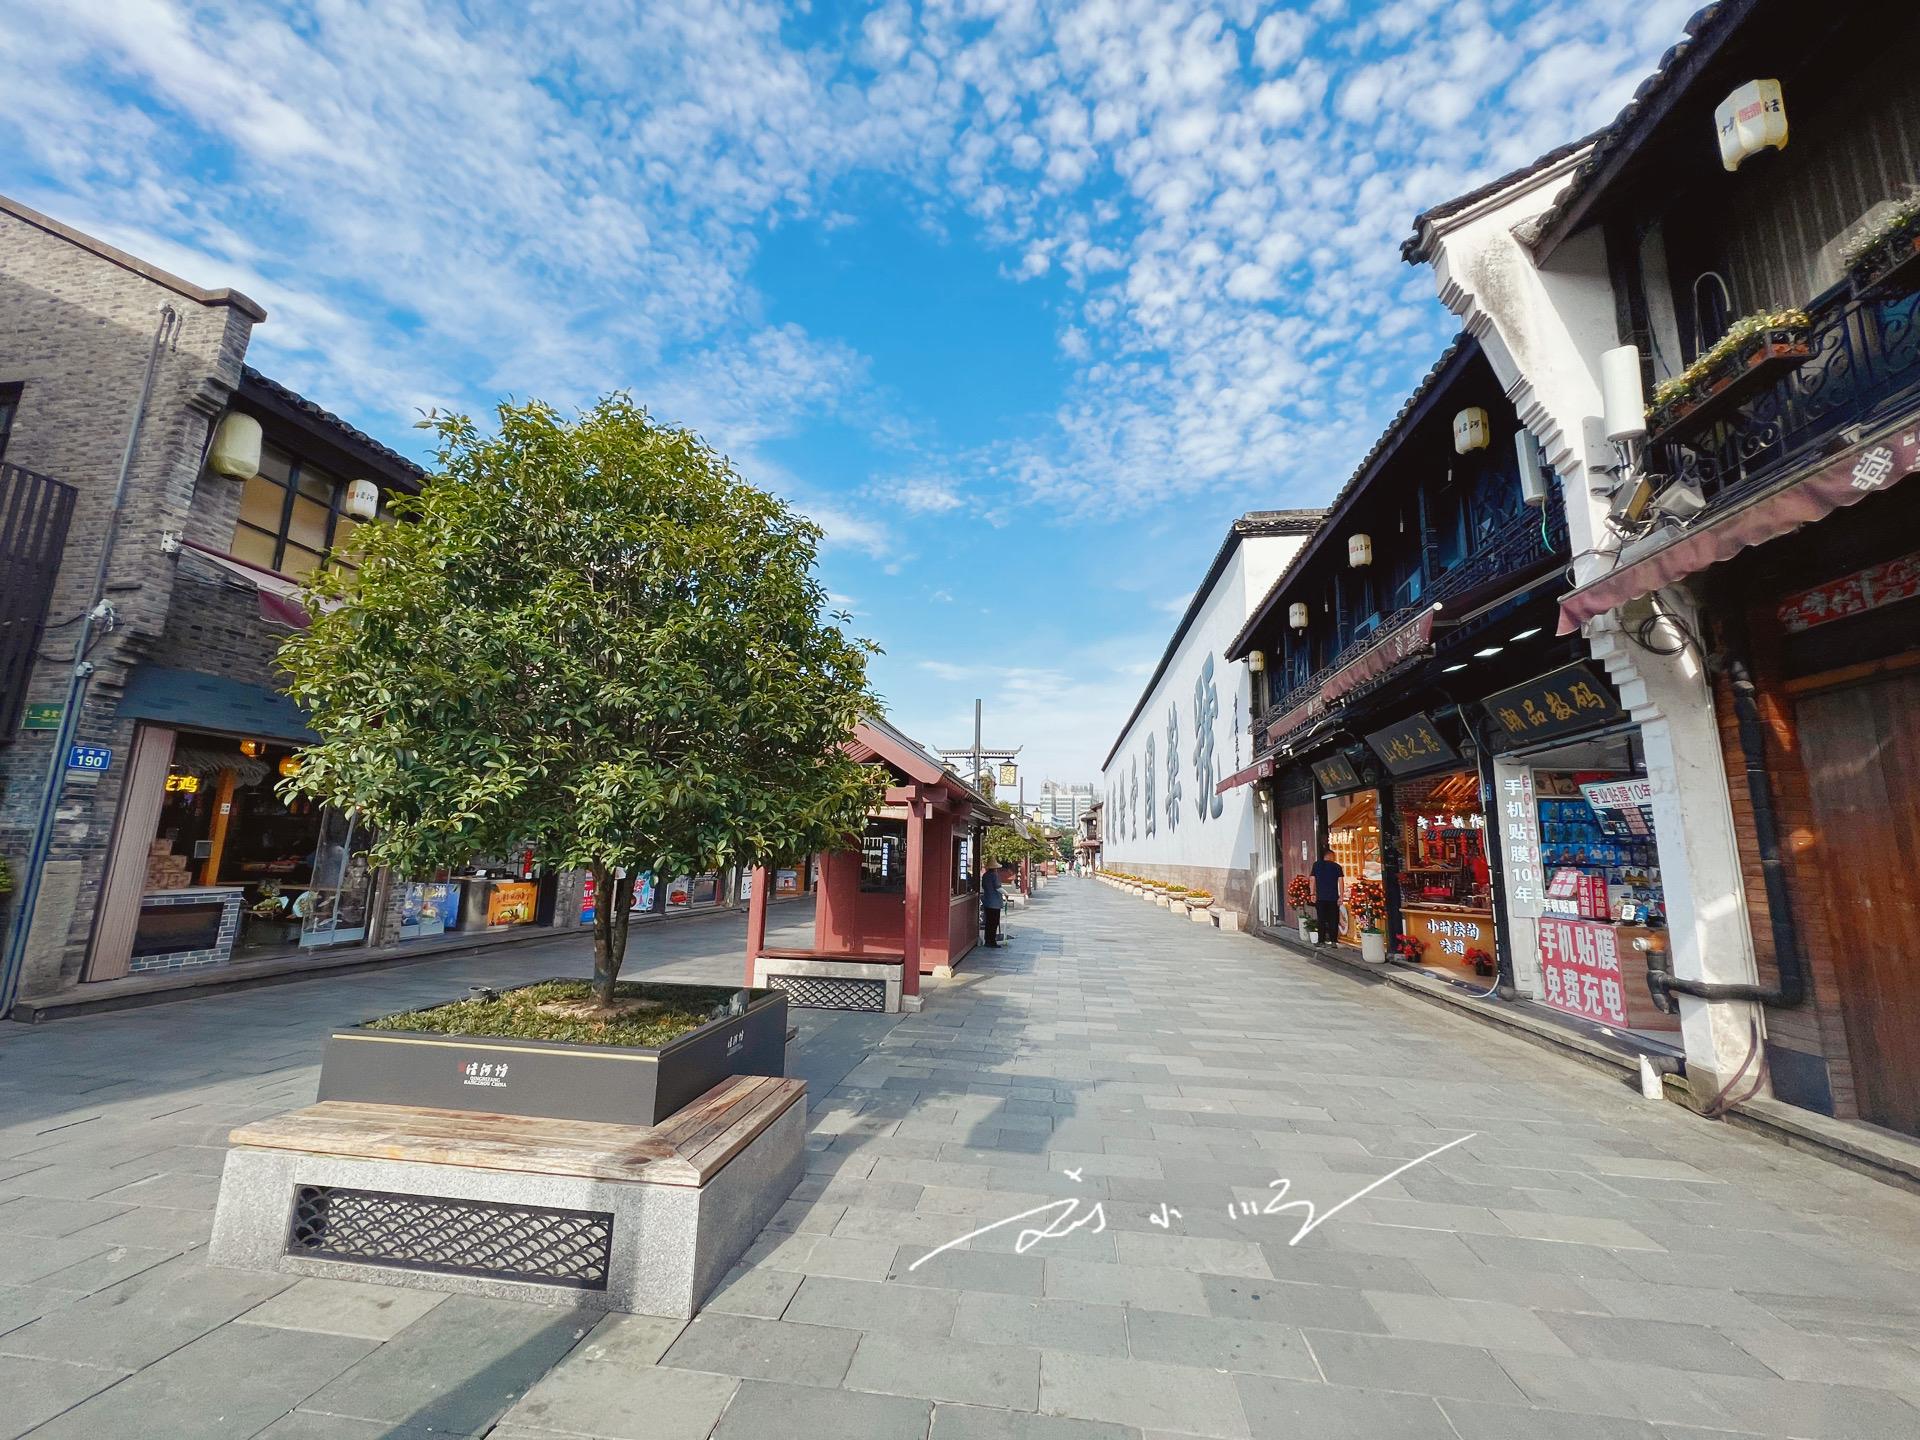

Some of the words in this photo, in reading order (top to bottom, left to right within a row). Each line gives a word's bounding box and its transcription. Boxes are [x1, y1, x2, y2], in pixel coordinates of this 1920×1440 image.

[78, 755, 102, 767] 190
[1540, 922, 1619, 972] 手机贴膜
[1545, 964, 1624, 1022] 免费充电
[465, 1062, 509, 1078] 清河坊
